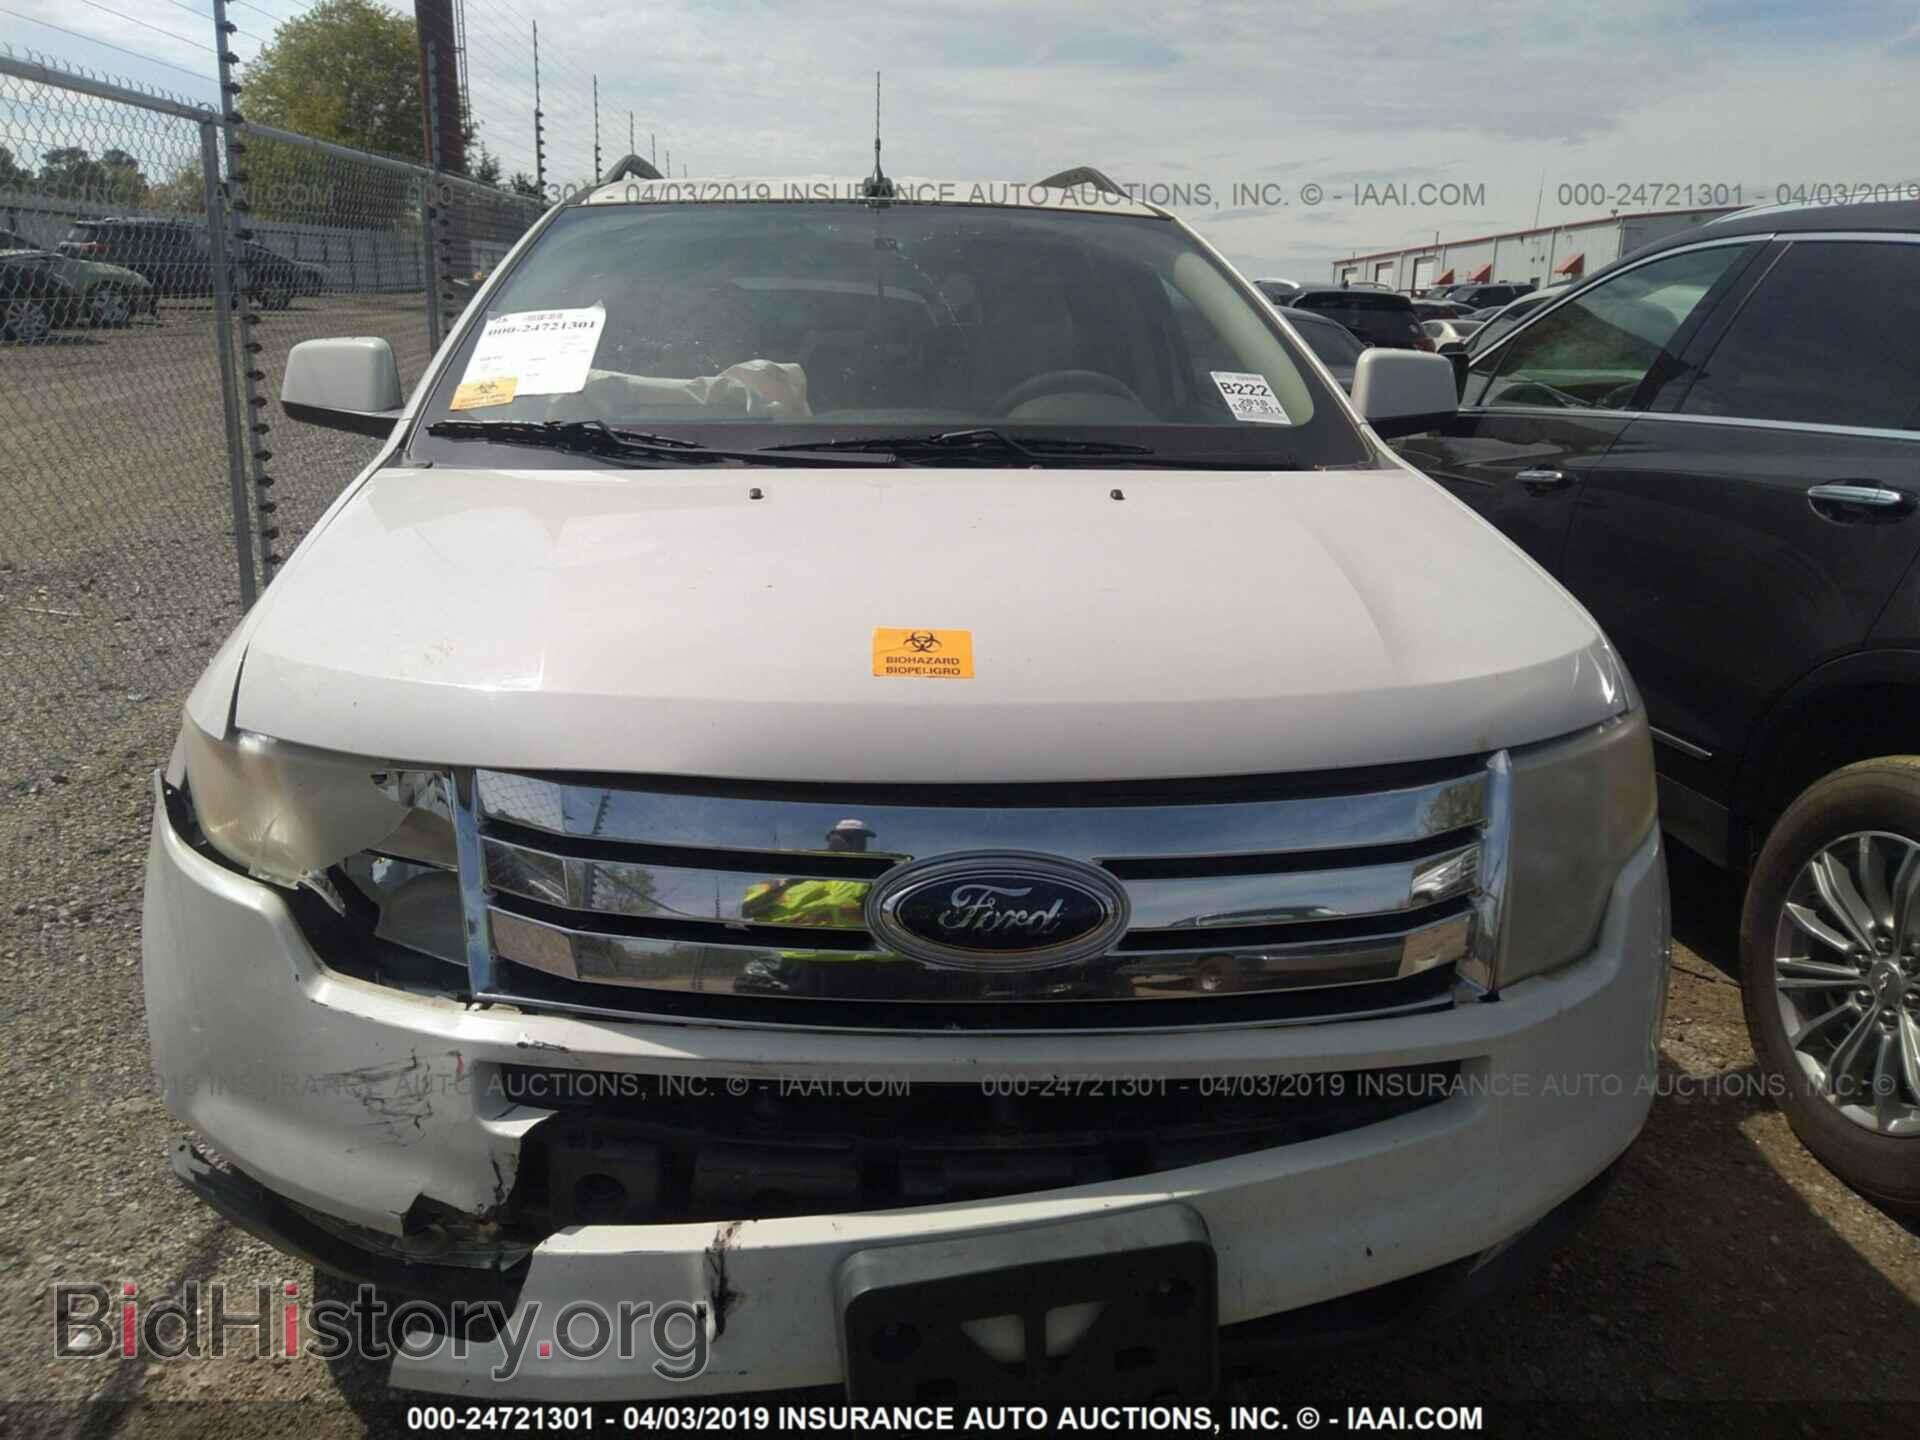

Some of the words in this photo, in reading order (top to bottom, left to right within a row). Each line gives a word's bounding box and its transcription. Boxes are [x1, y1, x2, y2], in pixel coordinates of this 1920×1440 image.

[1219, 382, 1272, 398] B222
[885, 655, 960, 665] BIOHAZARD
[885, 666, 961, 676] BIOPELIGRO
[938, 884, 1065, 932] Ford
